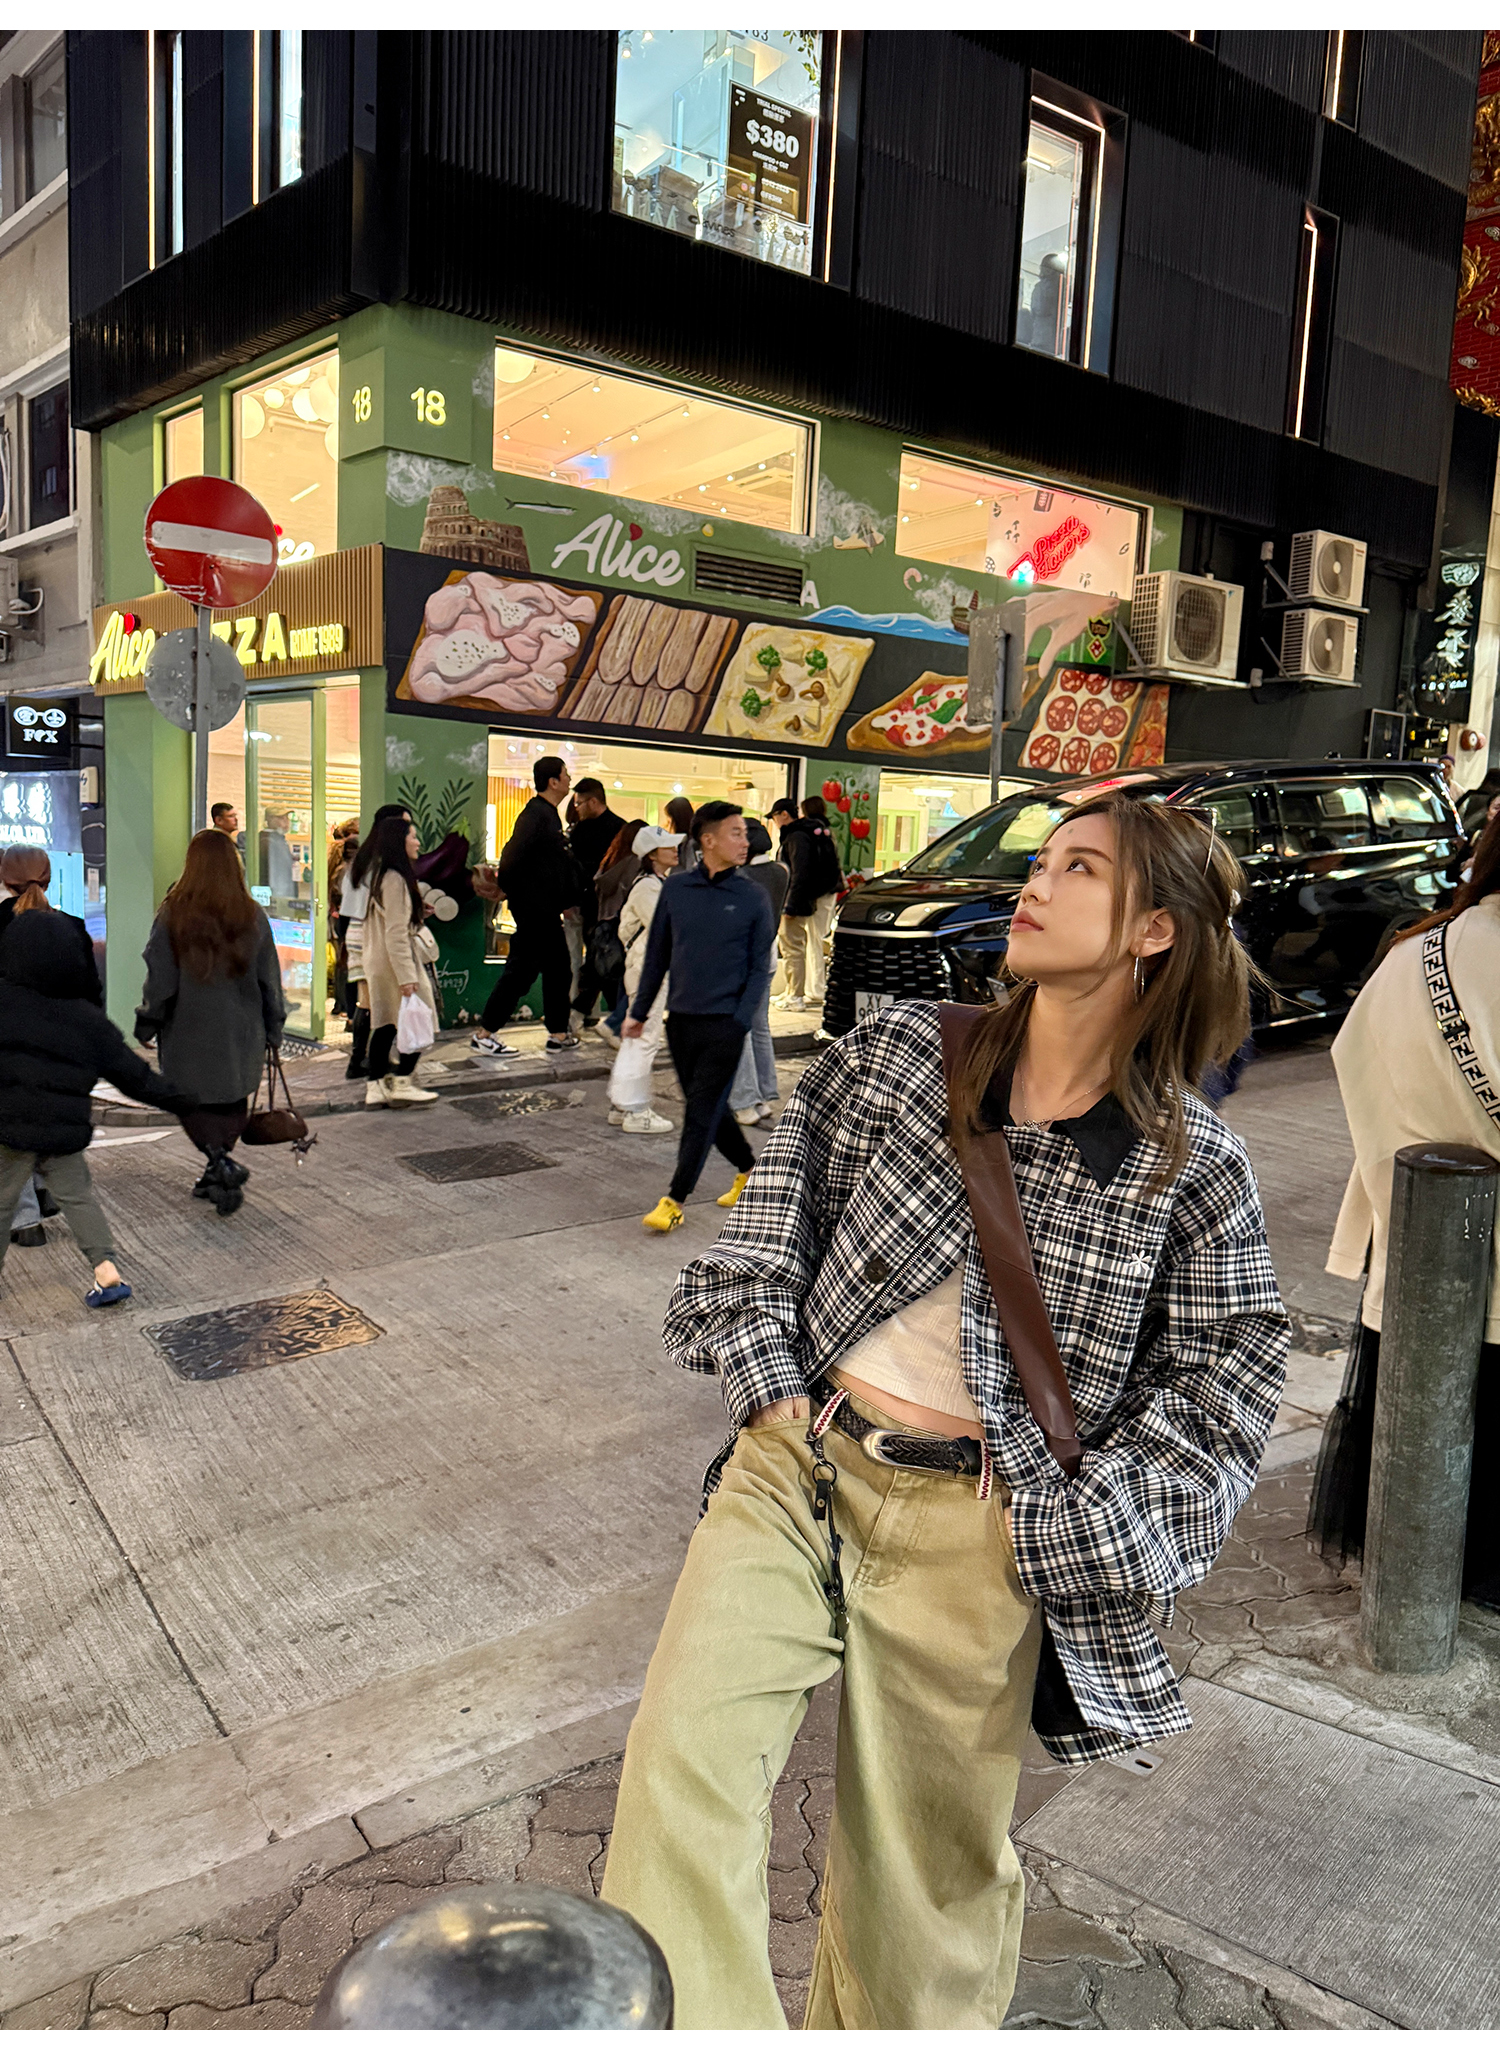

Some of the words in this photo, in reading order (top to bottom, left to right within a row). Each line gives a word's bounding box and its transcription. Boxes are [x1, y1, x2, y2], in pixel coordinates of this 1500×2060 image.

[745, 119, 800, 159] $380
[352, 386, 372, 424] 18
[410, 387, 447, 426] 18
[551, 513, 685, 587] Alice
[1033, 515, 1080, 565] Pizza
[1037, 523, 1090, 580] Lovers
[290, 627, 318, 659] ROME
[318, 623, 344, 655] 1989
[867, 993, 882, 1009] XY
